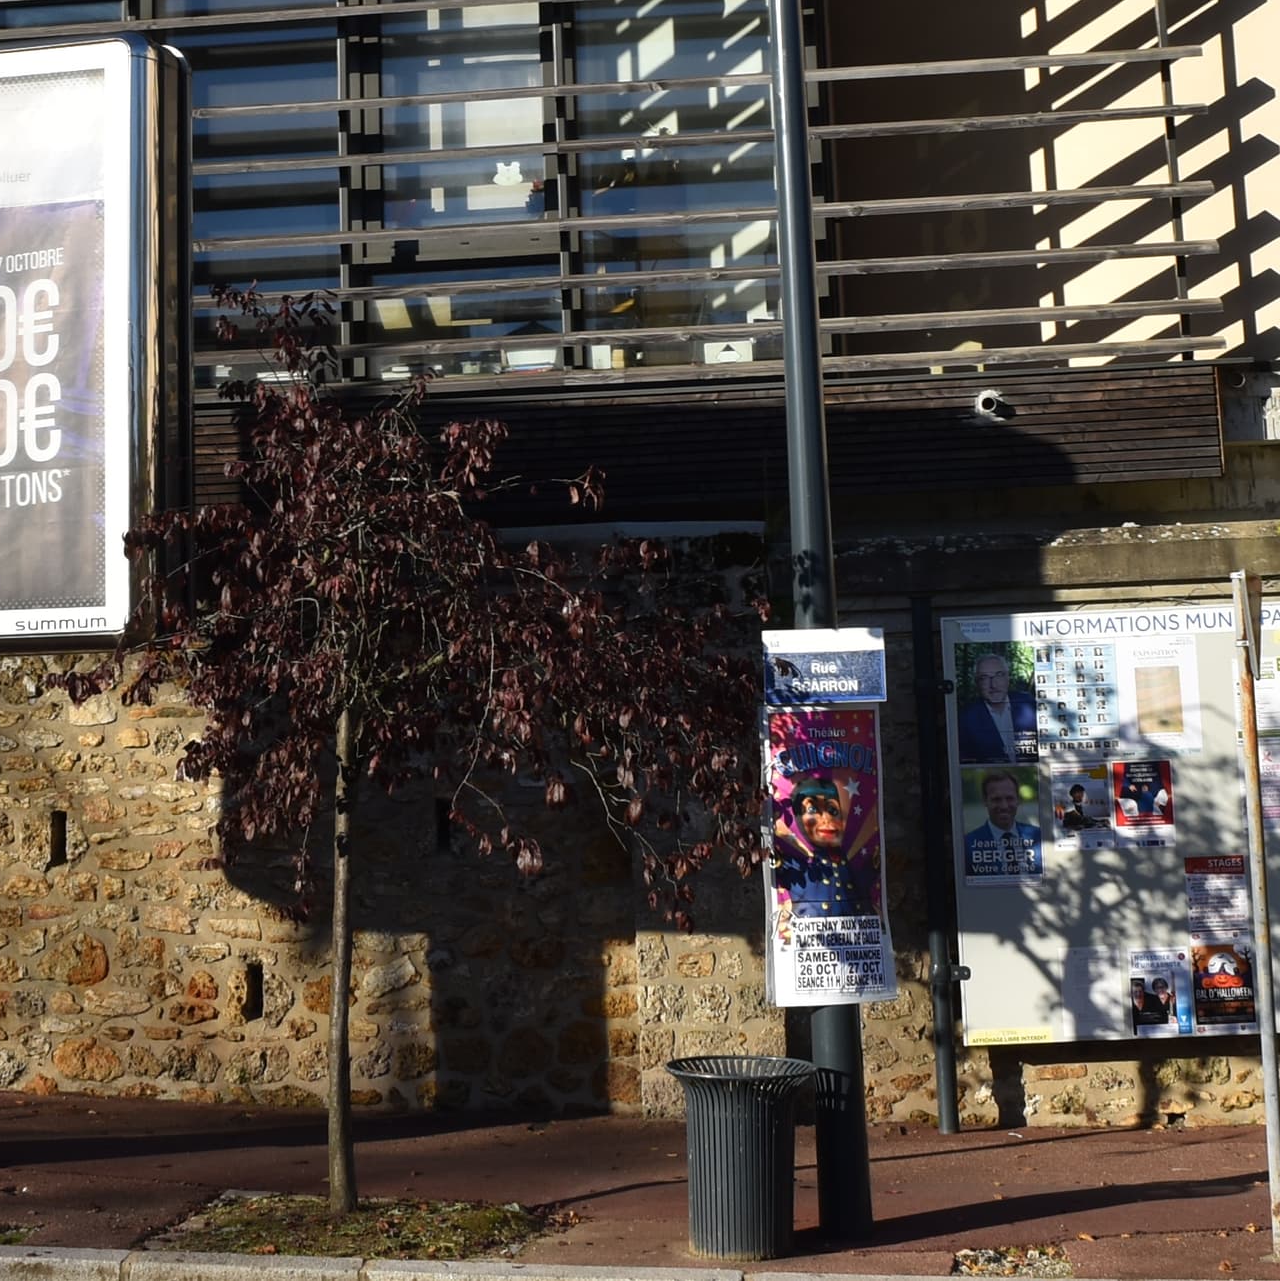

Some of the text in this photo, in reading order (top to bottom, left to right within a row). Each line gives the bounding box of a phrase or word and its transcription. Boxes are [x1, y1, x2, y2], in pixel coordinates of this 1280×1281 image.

[6, 247, 64, 274] OCTOBRE
[15, 617, 107, 631] summum
[1024, 614, 1180, 636] INFORMATIONS
[810, 661, 837, 674] Rue
[971, 838, 1035, 848] Jean-Didier
[972, 849, 1035, 863] BERGER
[1208, 858, 1242, 868] STAGES
[840, 918, 857, 930] AUX
[797, 950, 840, 963] SAMEDI
[846, 949, 882, 961] DIMANCHE
[800, 963, 838, 976] 26 OCT
[848, 961, 881, 974] 27 OCT
